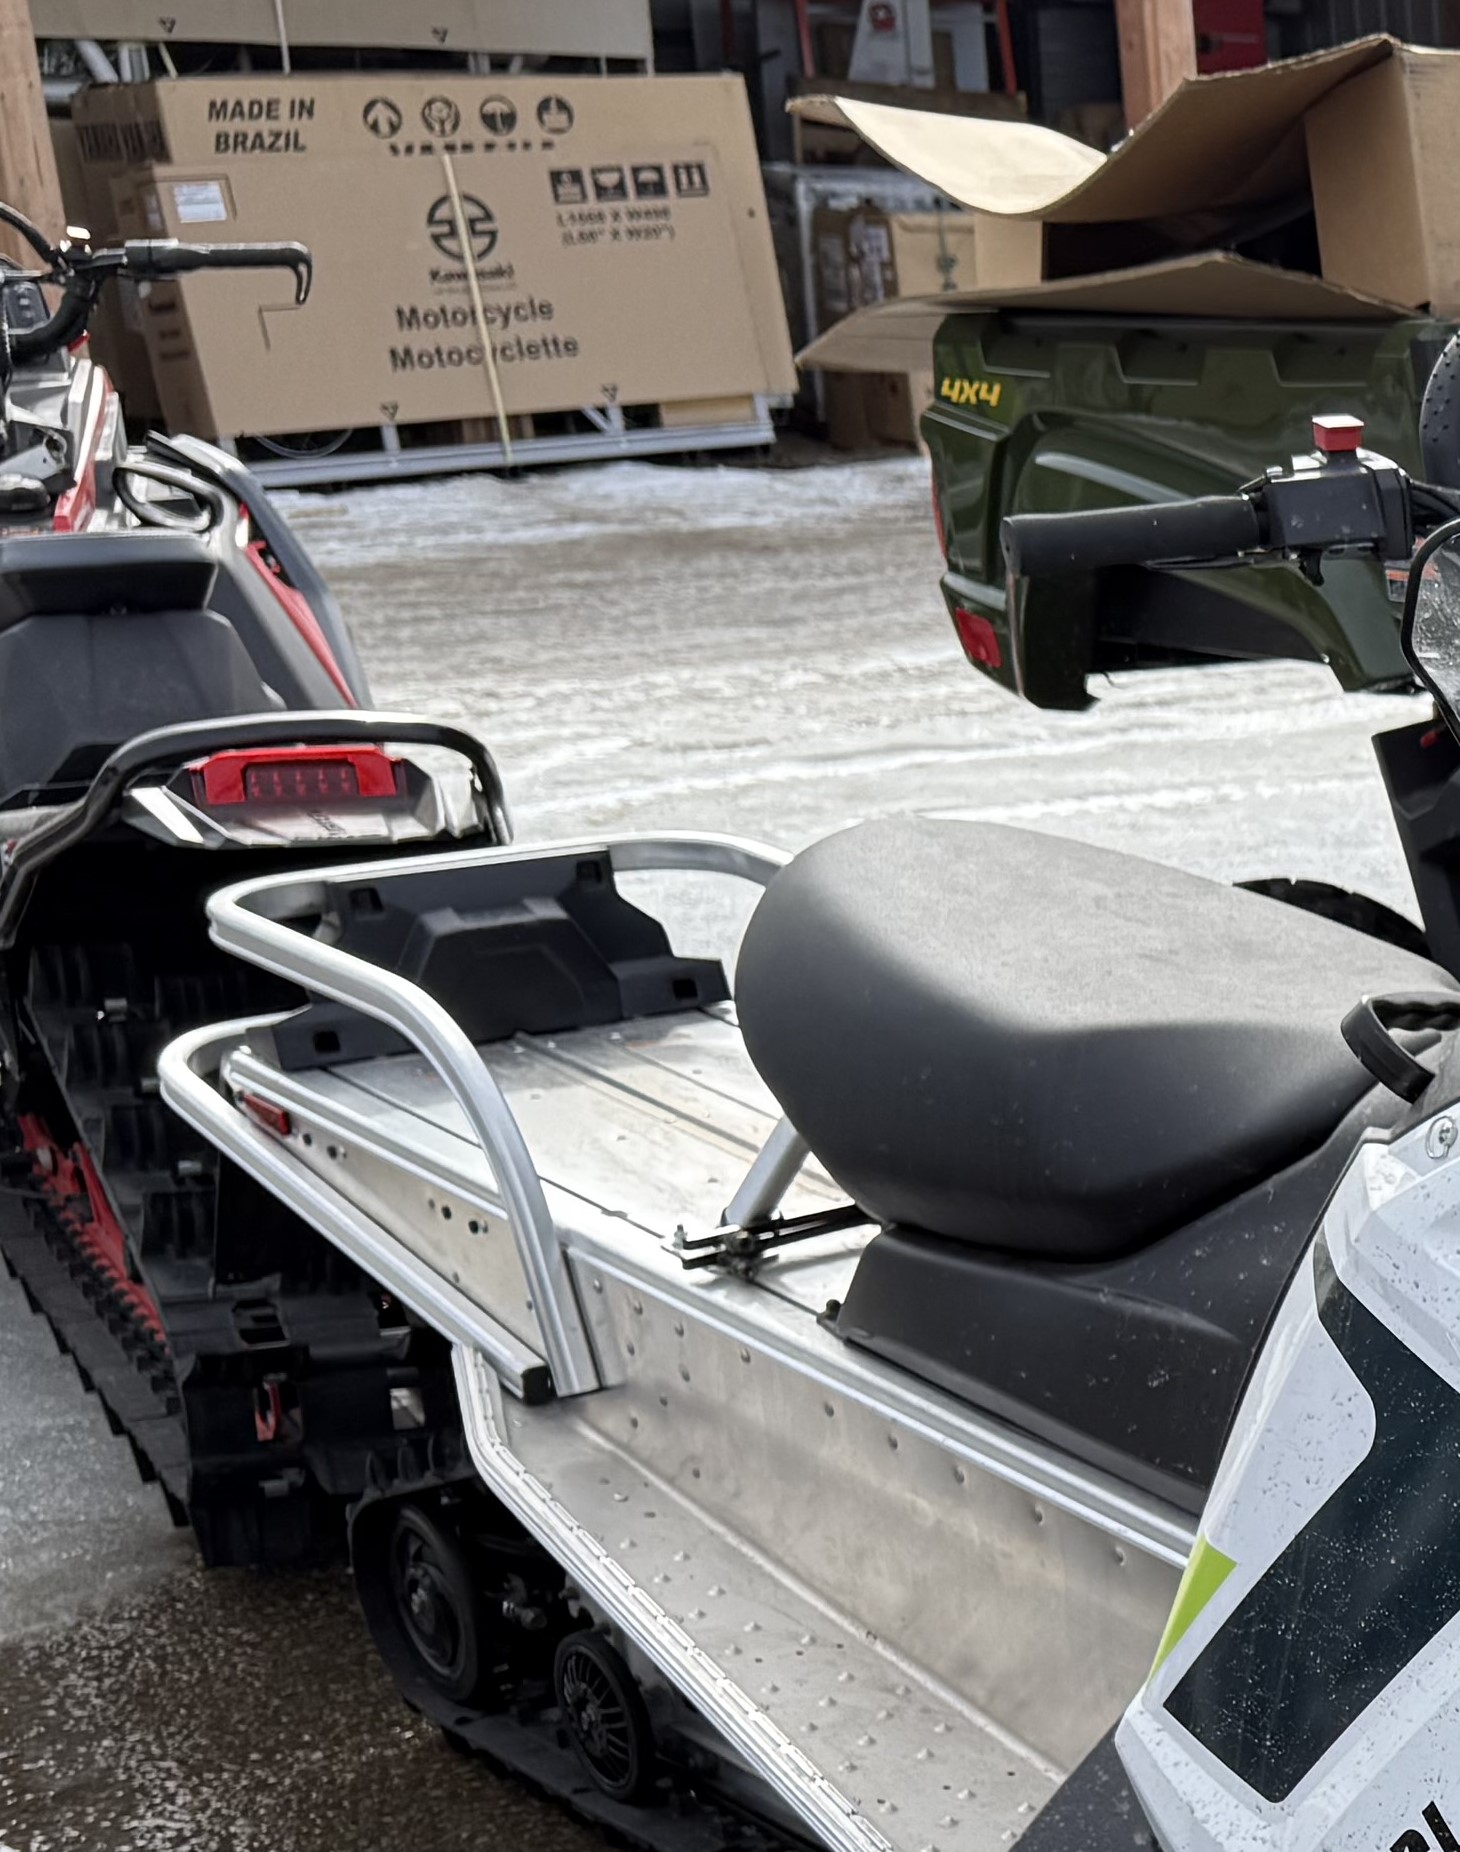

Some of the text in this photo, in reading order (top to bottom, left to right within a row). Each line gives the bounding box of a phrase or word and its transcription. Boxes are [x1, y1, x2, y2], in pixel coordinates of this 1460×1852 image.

[208, 97, 315, 122] MADE IN
[214, 129, 307, 154] BRAZIL
[396, 293, 555, 332] Motorcycle
